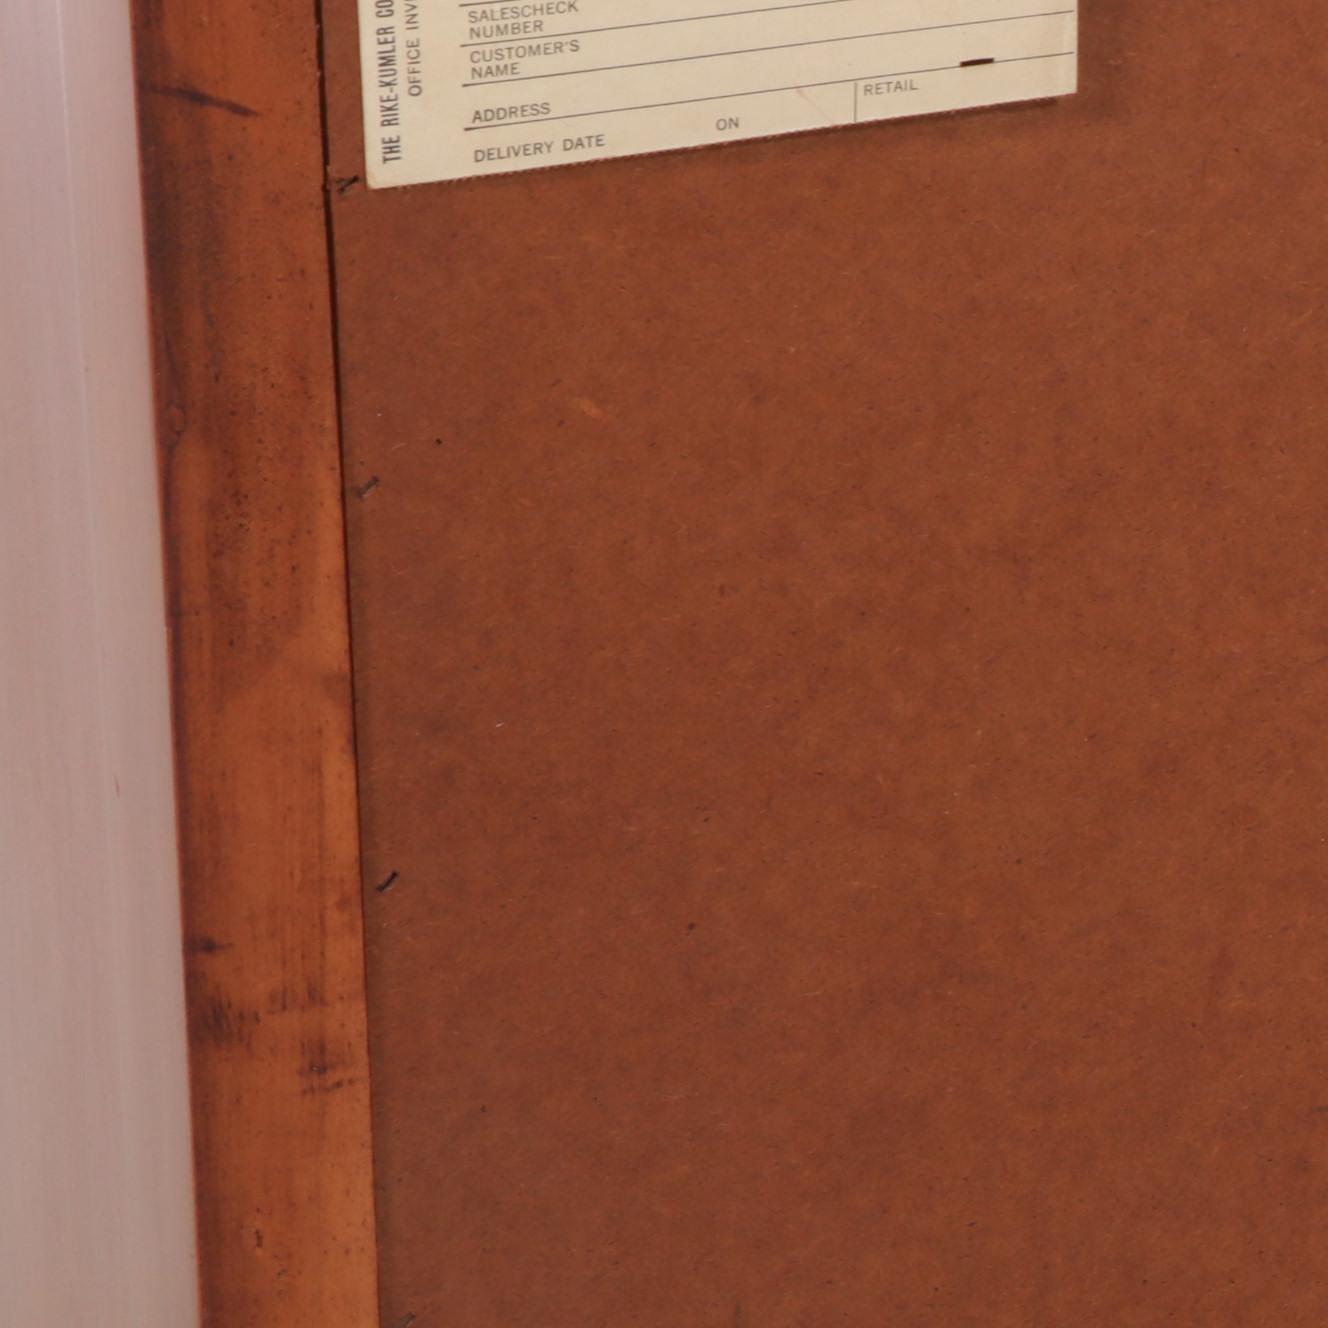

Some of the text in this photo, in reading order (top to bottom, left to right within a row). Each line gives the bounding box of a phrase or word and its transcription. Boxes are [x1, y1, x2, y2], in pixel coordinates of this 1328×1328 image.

[468, 0, 579, 24] SALESCHECK
[469, 20, 544, 39] NUMBER
[469, 39, 580, 64] CUSTOMER'S
[376, 25, 399, 127] RIKE-KUMLER
[406, 38, 423, 97] OFFICE
[471, 62, 521, 80] NAME
[863, 79, 920, 96] RETAIL
[472, 102, 551, 123] ADDRESS
[382, 135, 402, 164] THE
[473, 117, 740, 163] DELIVERY DATE ON
